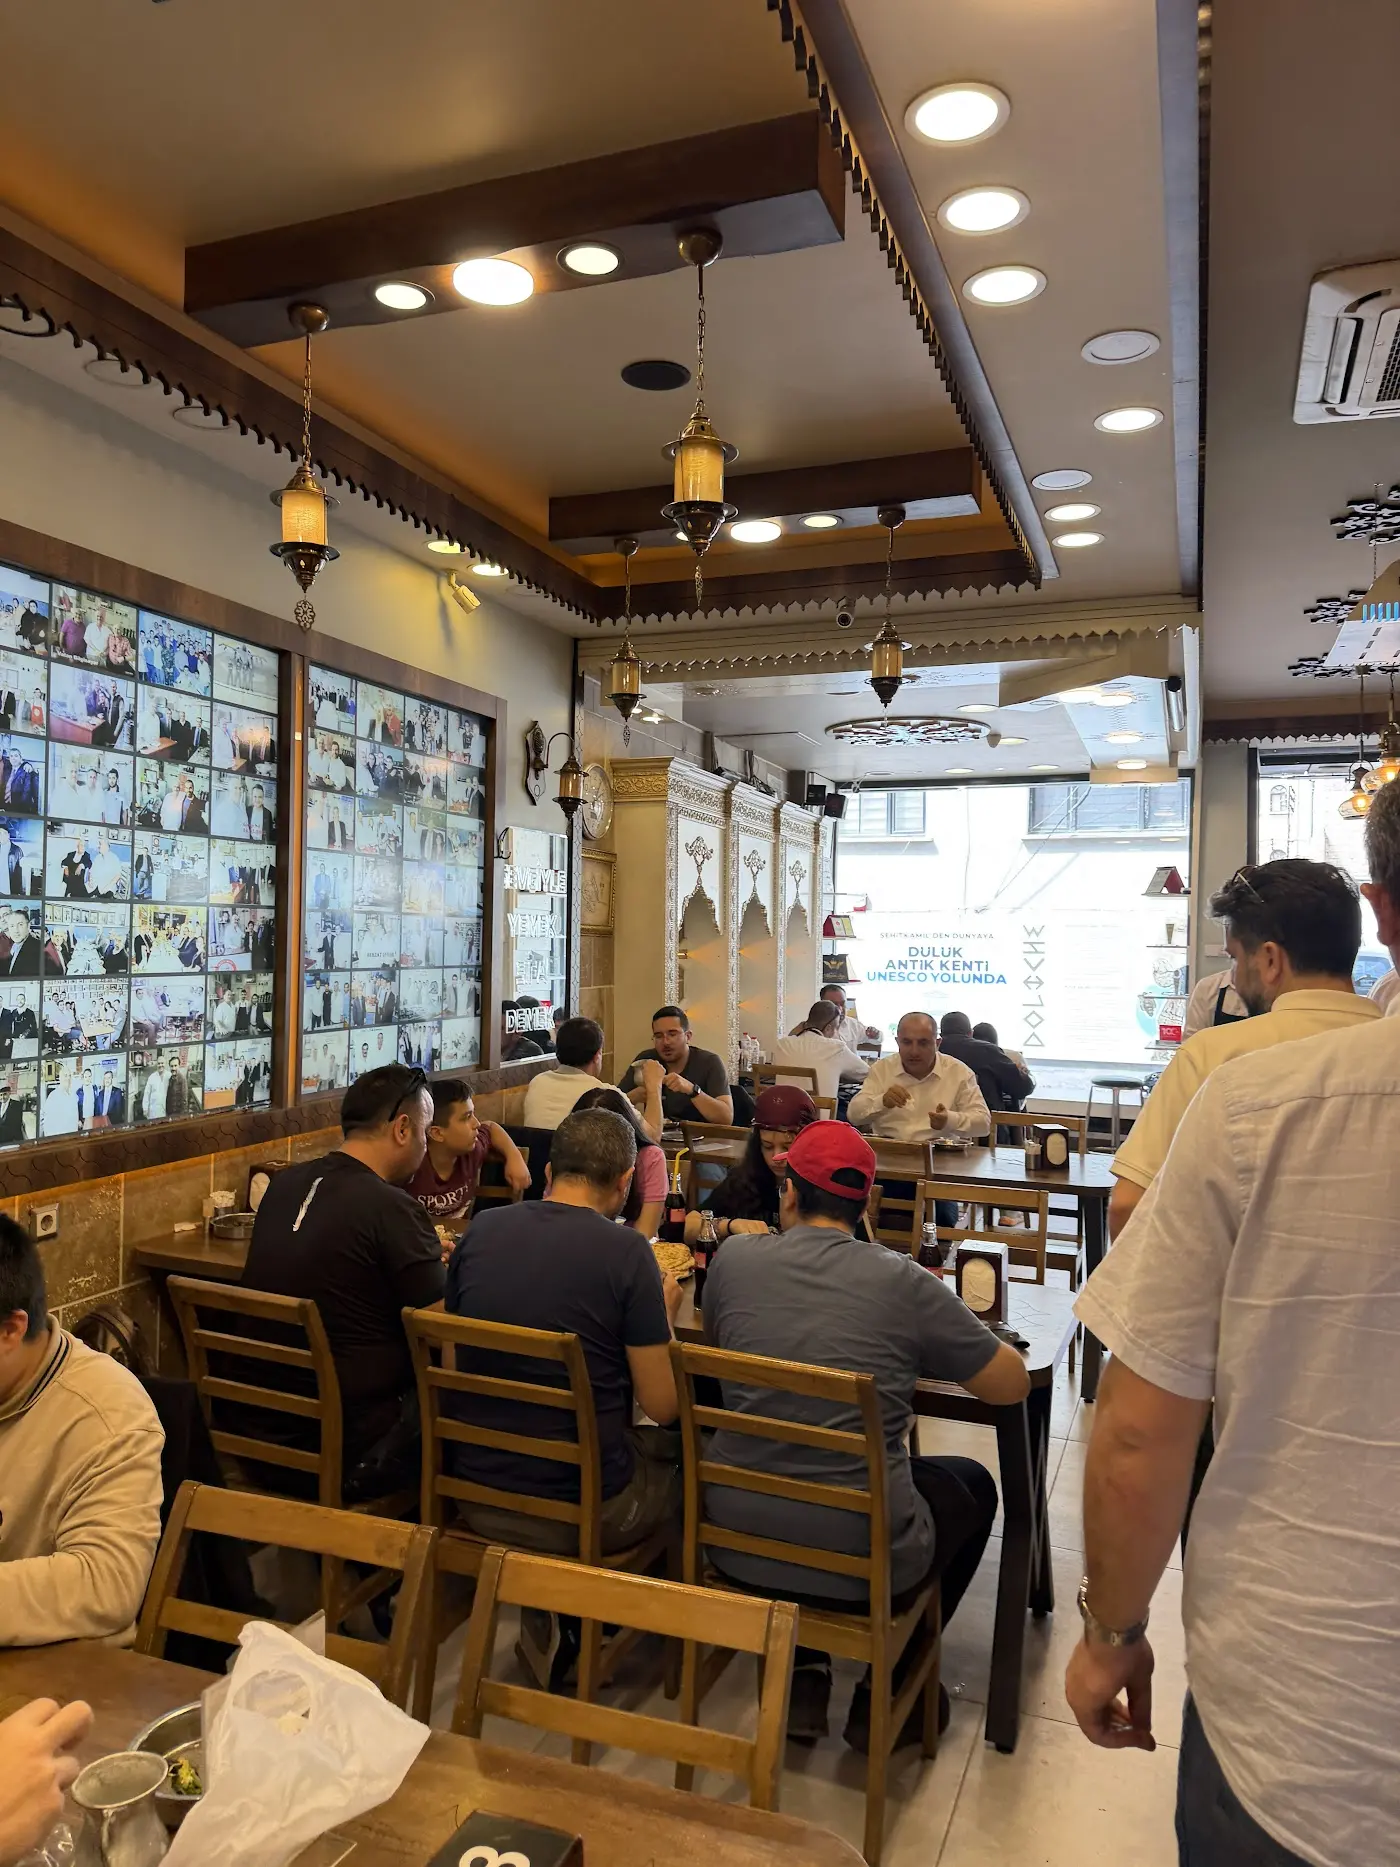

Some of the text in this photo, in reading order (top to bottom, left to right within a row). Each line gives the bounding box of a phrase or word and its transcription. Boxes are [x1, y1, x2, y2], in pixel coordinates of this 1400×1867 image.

[507, 913, 558, 938] YEMEK
[867, 971, 1007, 984] UNESCO YOLUNDA
[505, 1005, 556, 1034] DEMEK
